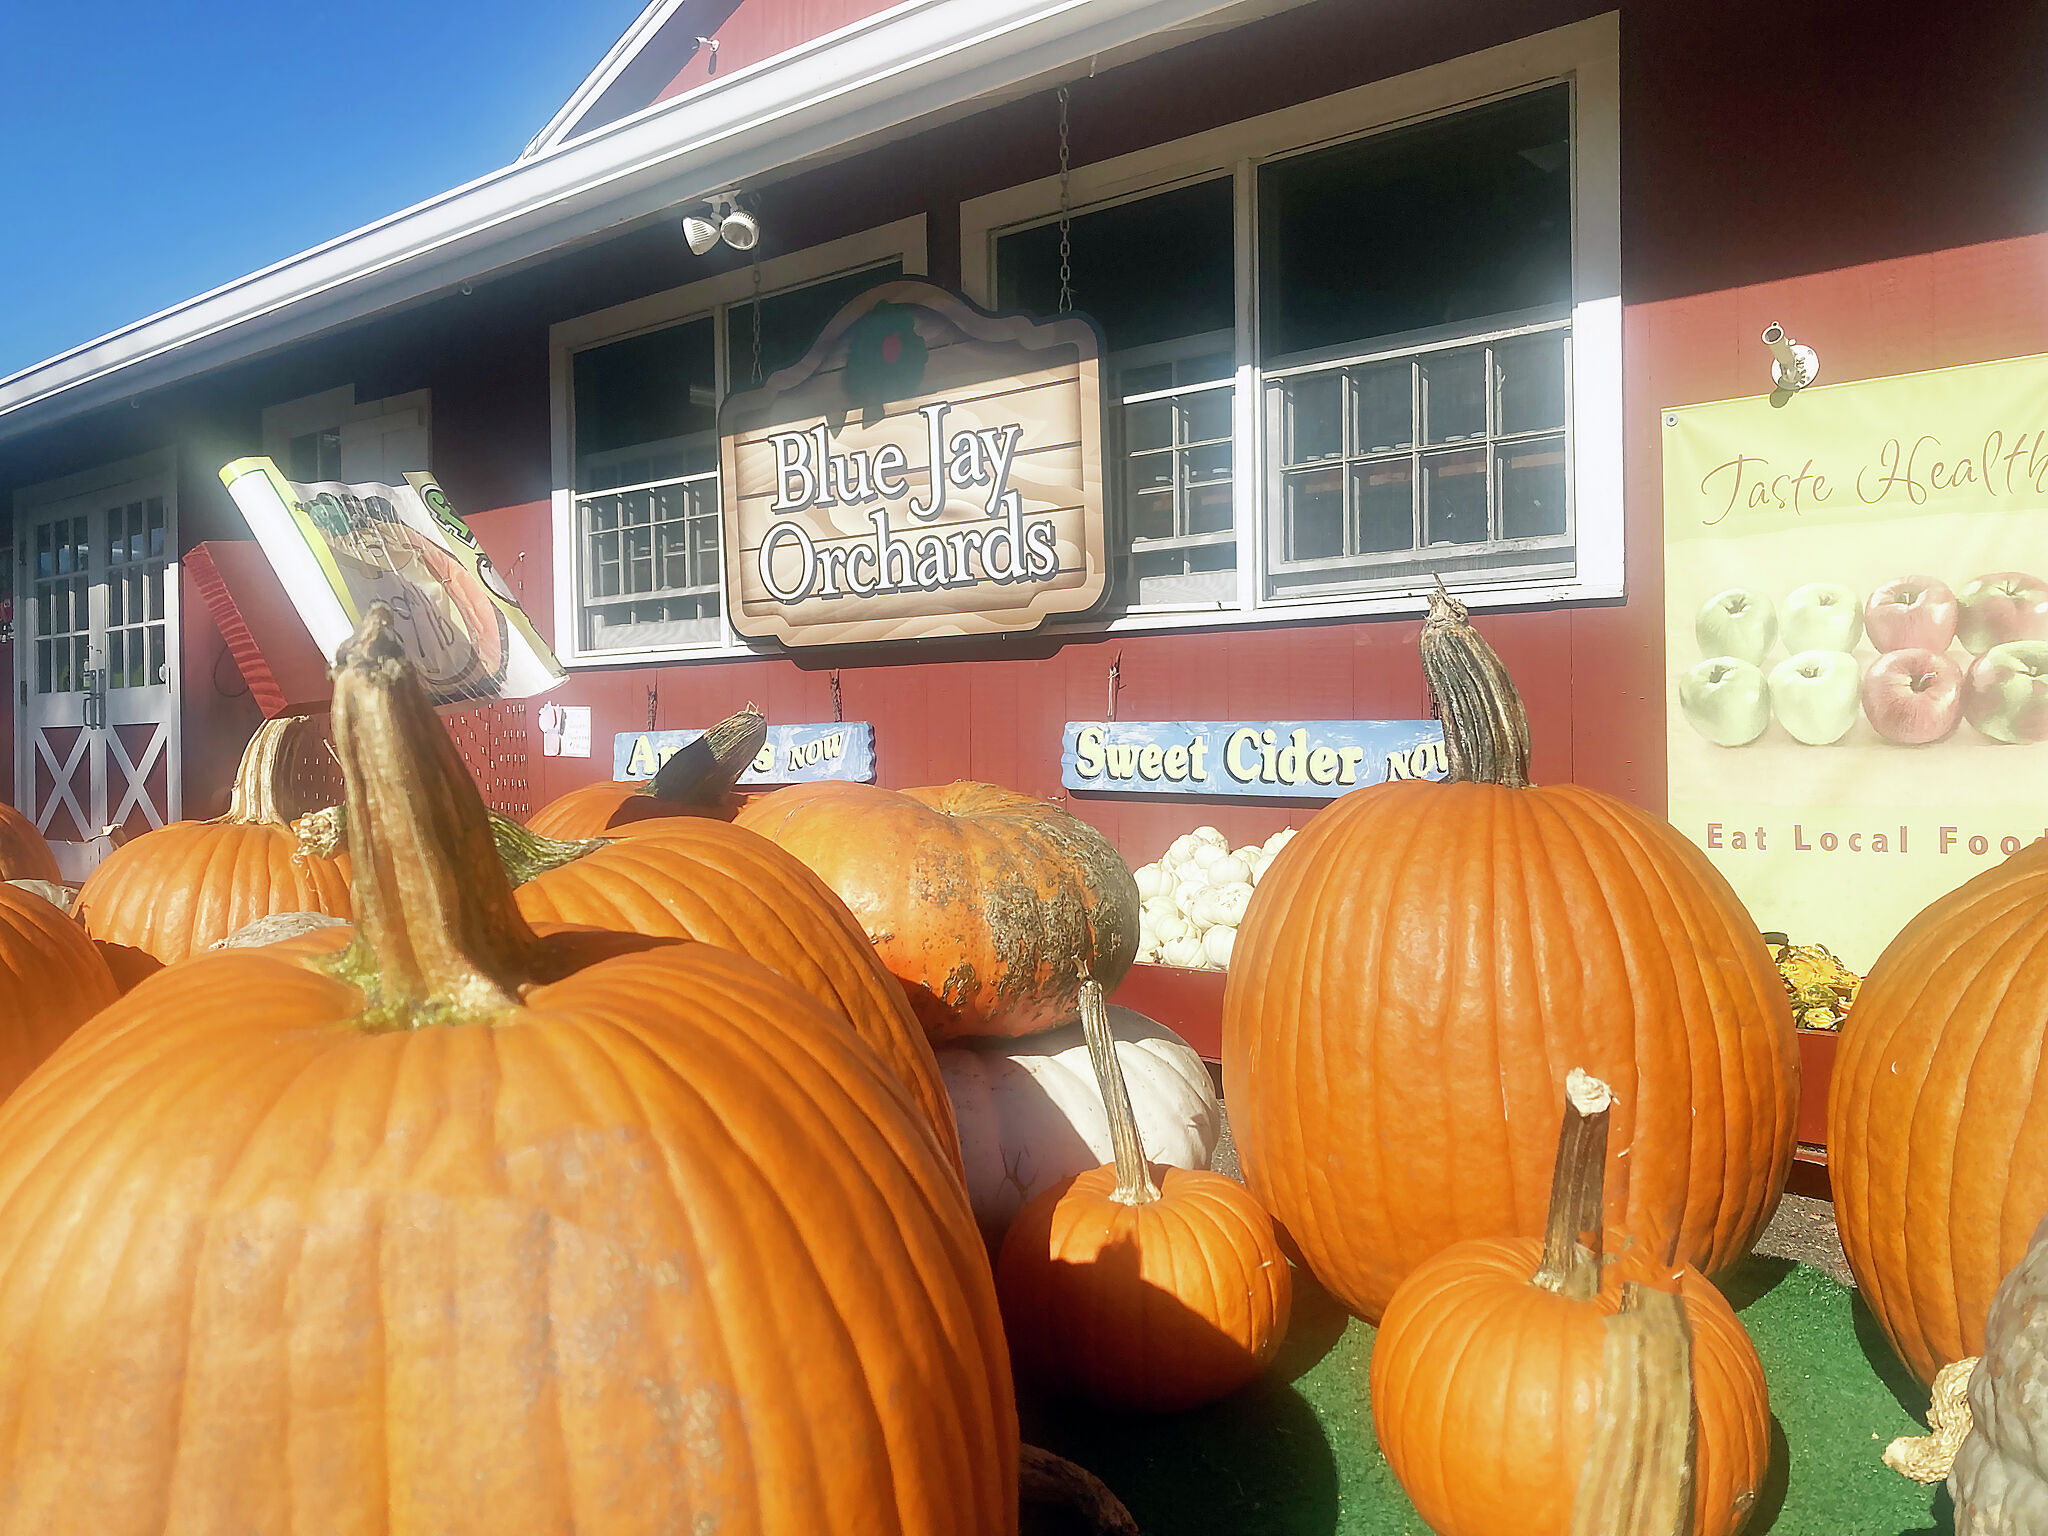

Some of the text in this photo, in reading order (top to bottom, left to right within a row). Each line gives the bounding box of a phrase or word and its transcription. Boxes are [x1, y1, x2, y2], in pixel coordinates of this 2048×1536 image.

[768, 401, 1023, 521] Blue Jay
[1701, 454, 1833, 525] Taste
[758, 488, 1058, 605] Orchards
[788, 732, 844, 771] NOW
[1075, 727, 1208, 782] Sweet
[1223, 727, 1363, 785] Cider
[1707, 823, 2048, 856] Eat Local Foo
